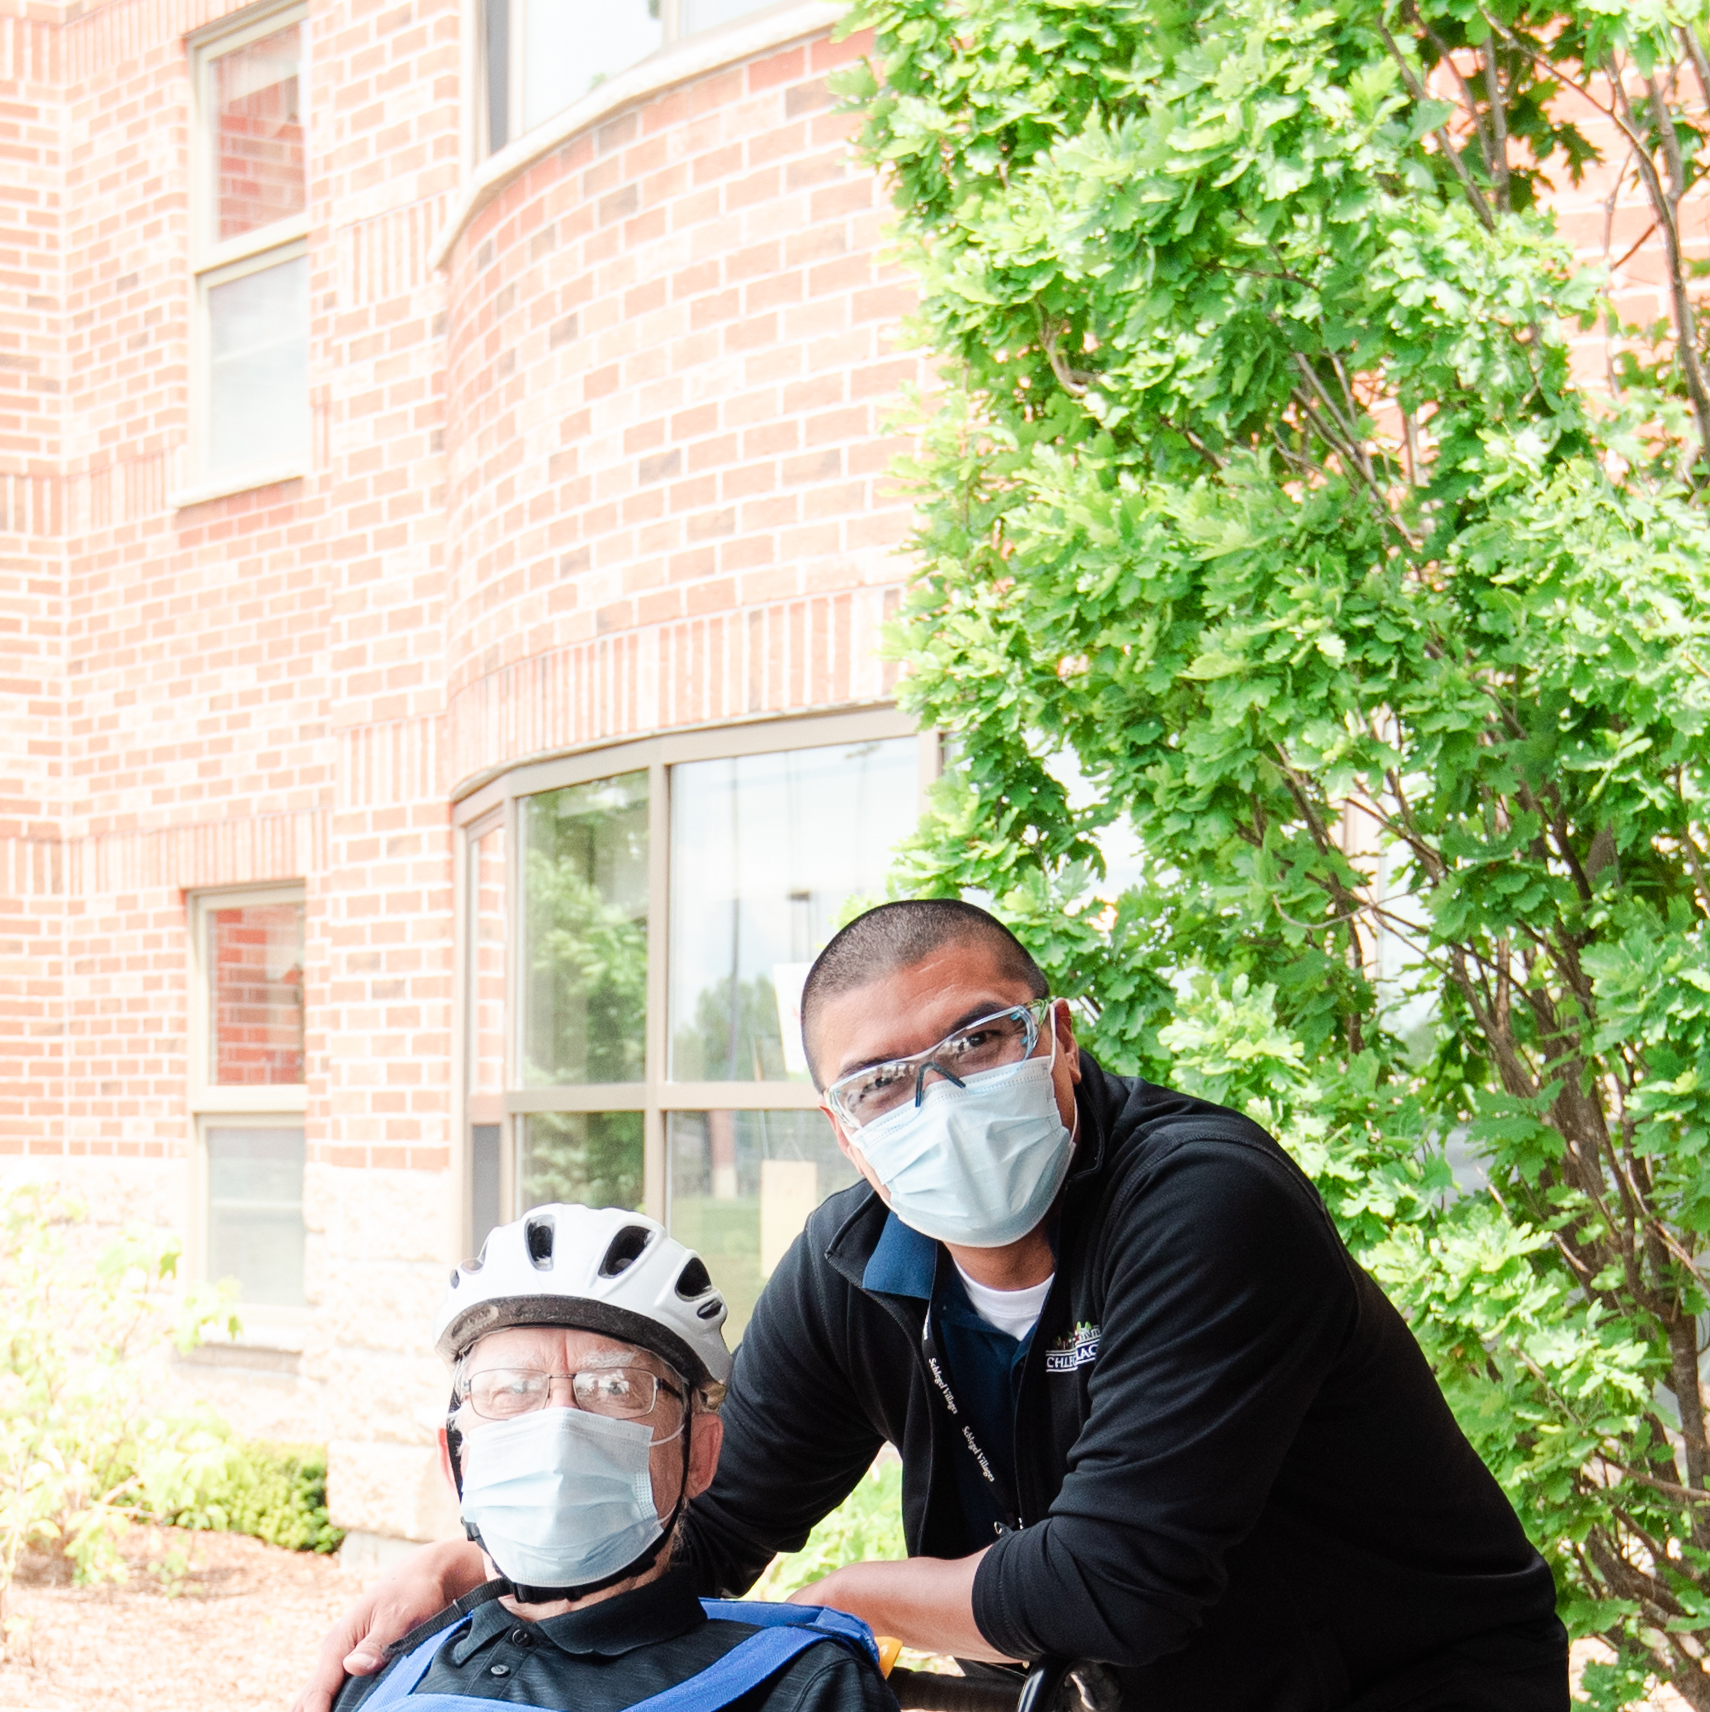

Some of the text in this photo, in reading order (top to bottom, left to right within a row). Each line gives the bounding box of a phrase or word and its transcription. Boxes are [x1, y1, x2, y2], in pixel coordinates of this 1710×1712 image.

[928, 1357, 959, 1415] Schlegel Villages
[961, 1425, 996, 1482] Schlegel Villages
